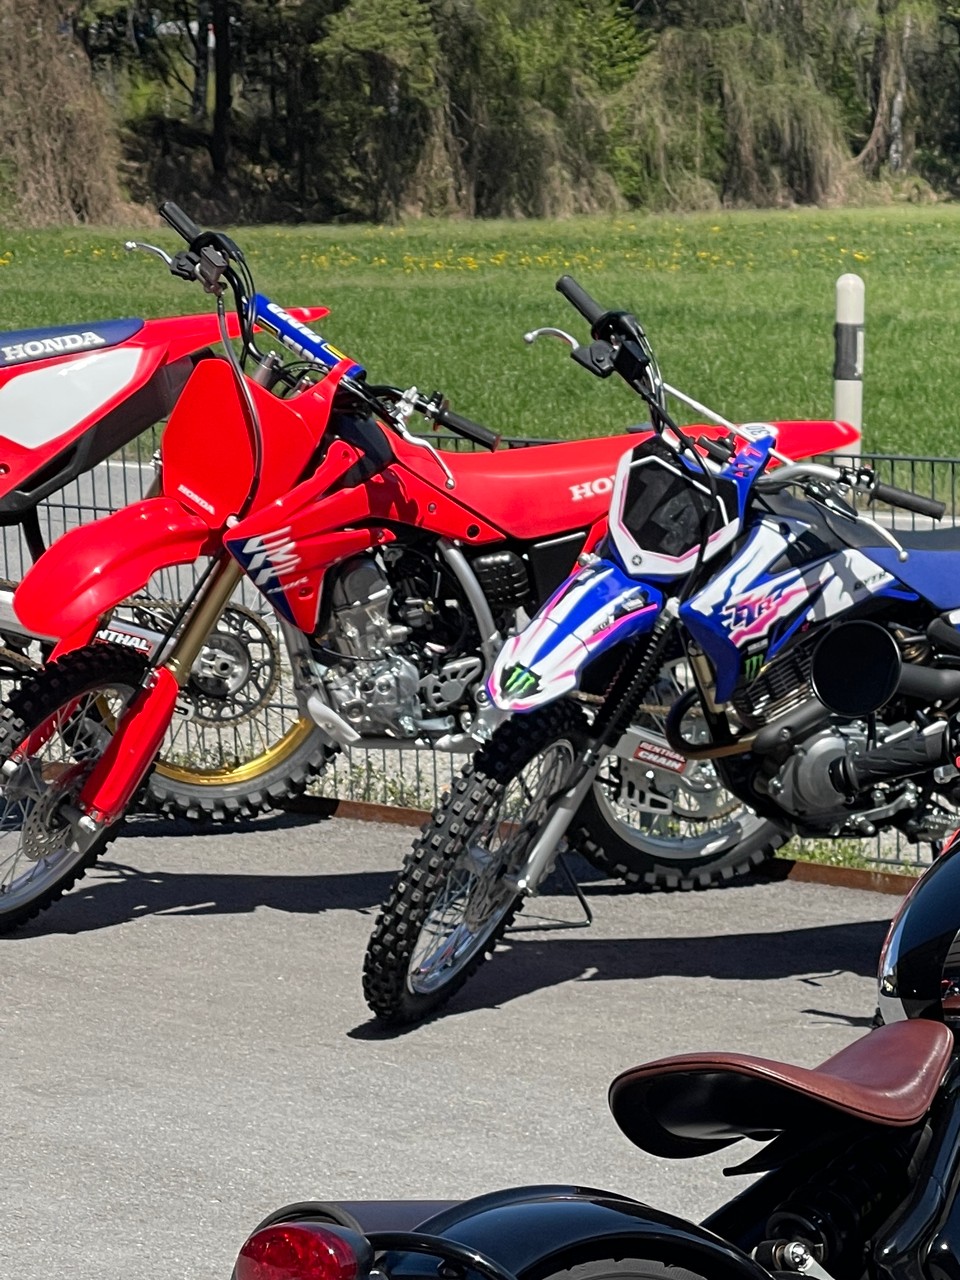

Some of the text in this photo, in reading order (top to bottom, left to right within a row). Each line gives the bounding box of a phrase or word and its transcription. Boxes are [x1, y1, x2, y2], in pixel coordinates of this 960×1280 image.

[1, 331, 106, 361] HONDA
[178, 484, 215, 515] HONDA
[569, 474, 615, 501] HO
[638, 750, 682, 770] CHAIN
